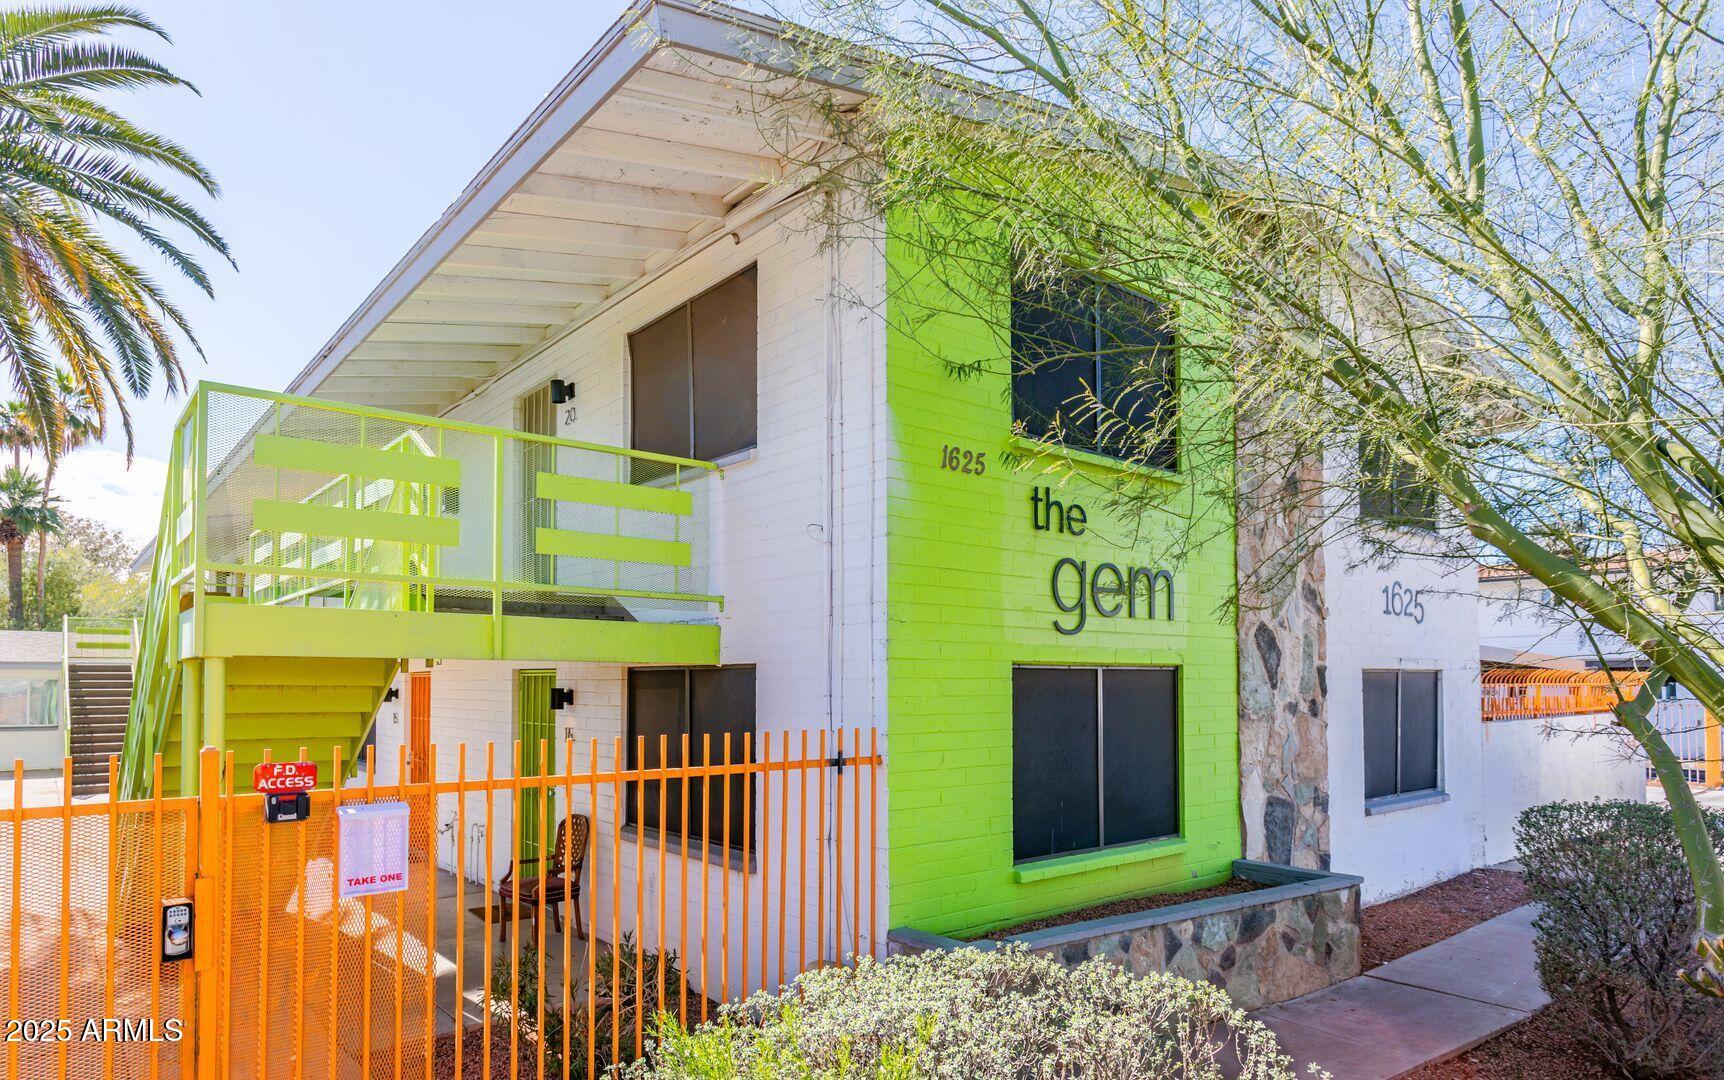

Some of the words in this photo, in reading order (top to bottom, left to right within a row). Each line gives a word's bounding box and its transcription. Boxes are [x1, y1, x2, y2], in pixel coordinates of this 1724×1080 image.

[940, 444, 986, 475] 1625
[1031, 486, 1087, 536] the
[1053, 557, 1175, 635] gem
[1382, 580, 1425, 624] 1625
[257, 776, 315, 790] ACCESS
[273, 764, 299, 776] F.D.
[346, 875, 377, 887] TAKE
[380, 872, 403, 883] ONE
